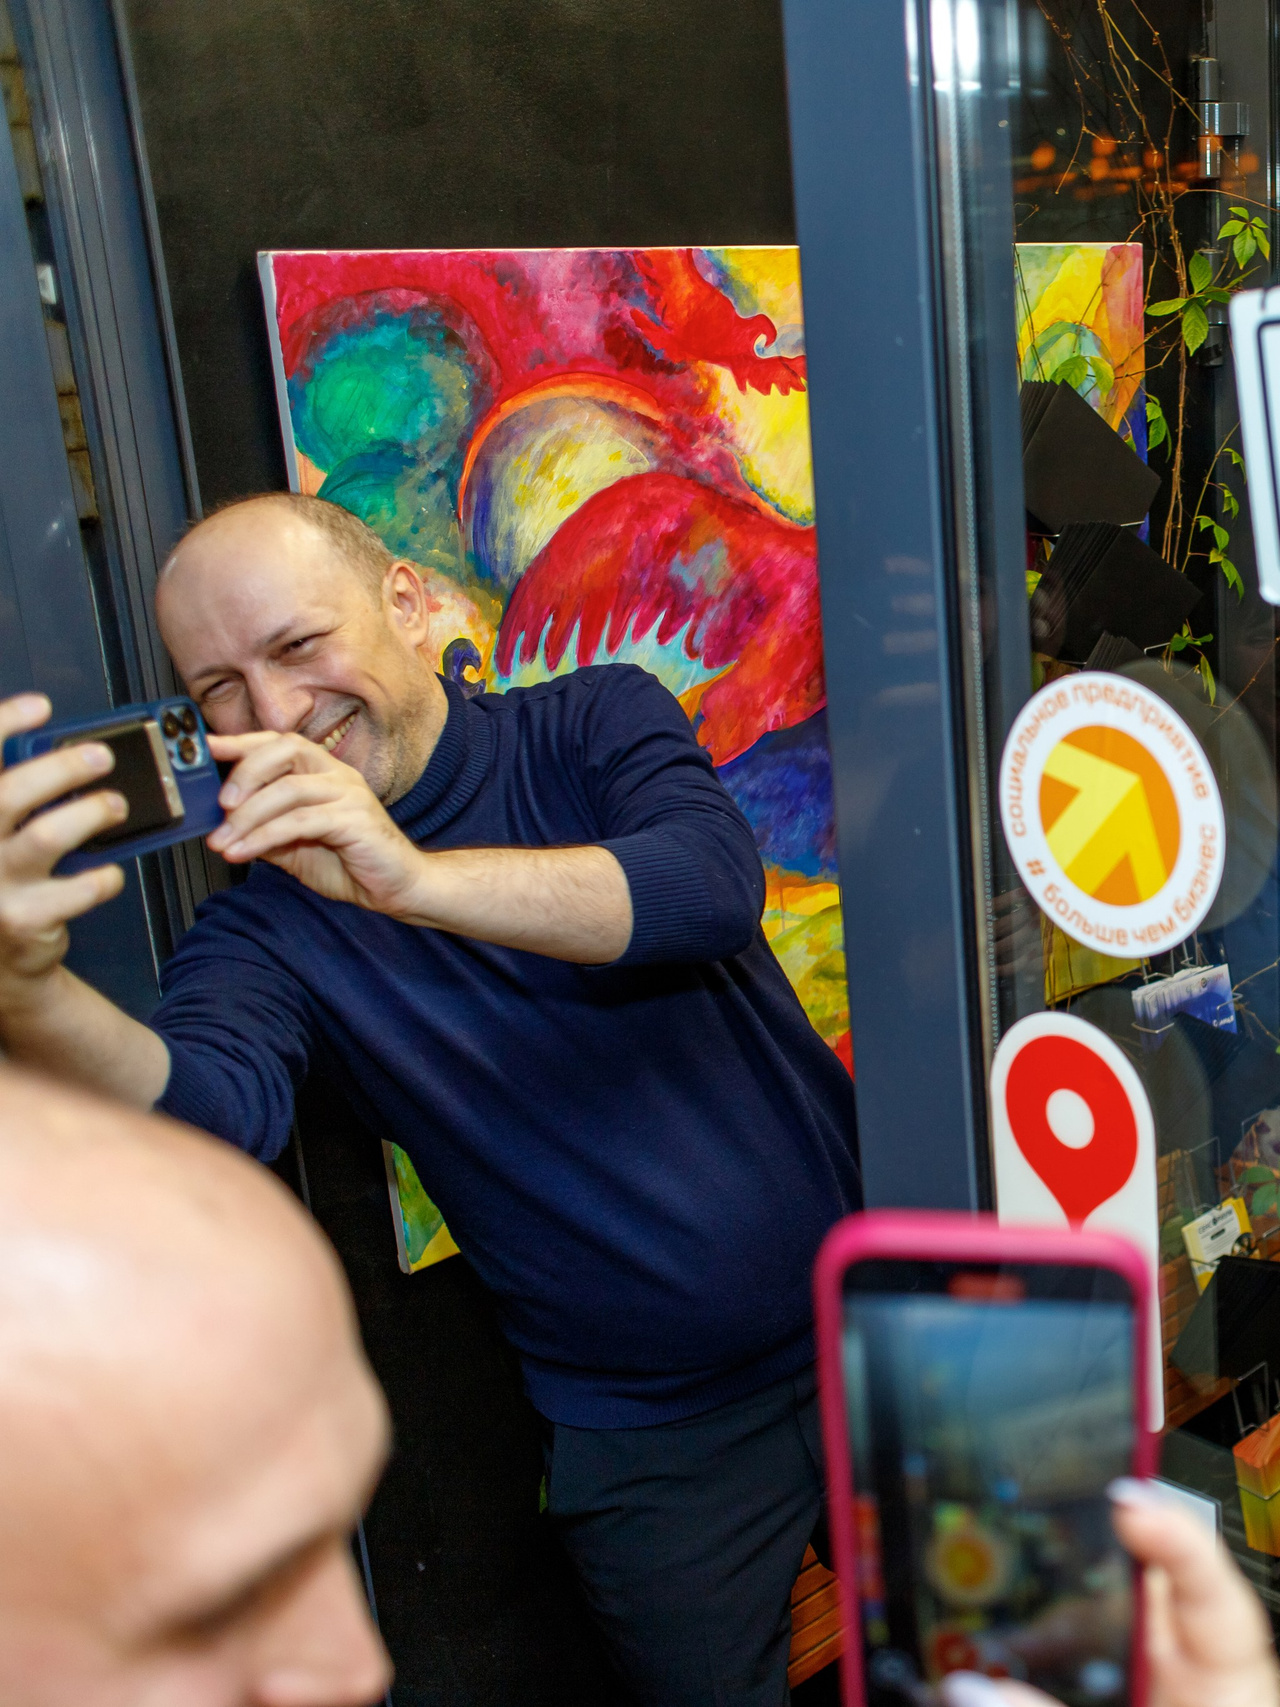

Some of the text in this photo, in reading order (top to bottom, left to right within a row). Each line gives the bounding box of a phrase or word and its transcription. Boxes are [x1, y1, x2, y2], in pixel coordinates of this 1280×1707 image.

[1009, 682, 1210, 838] социальное предприятие
[1134, 918, 1178, 945] чем
[1173, 825, 1216, 923] бизнес
